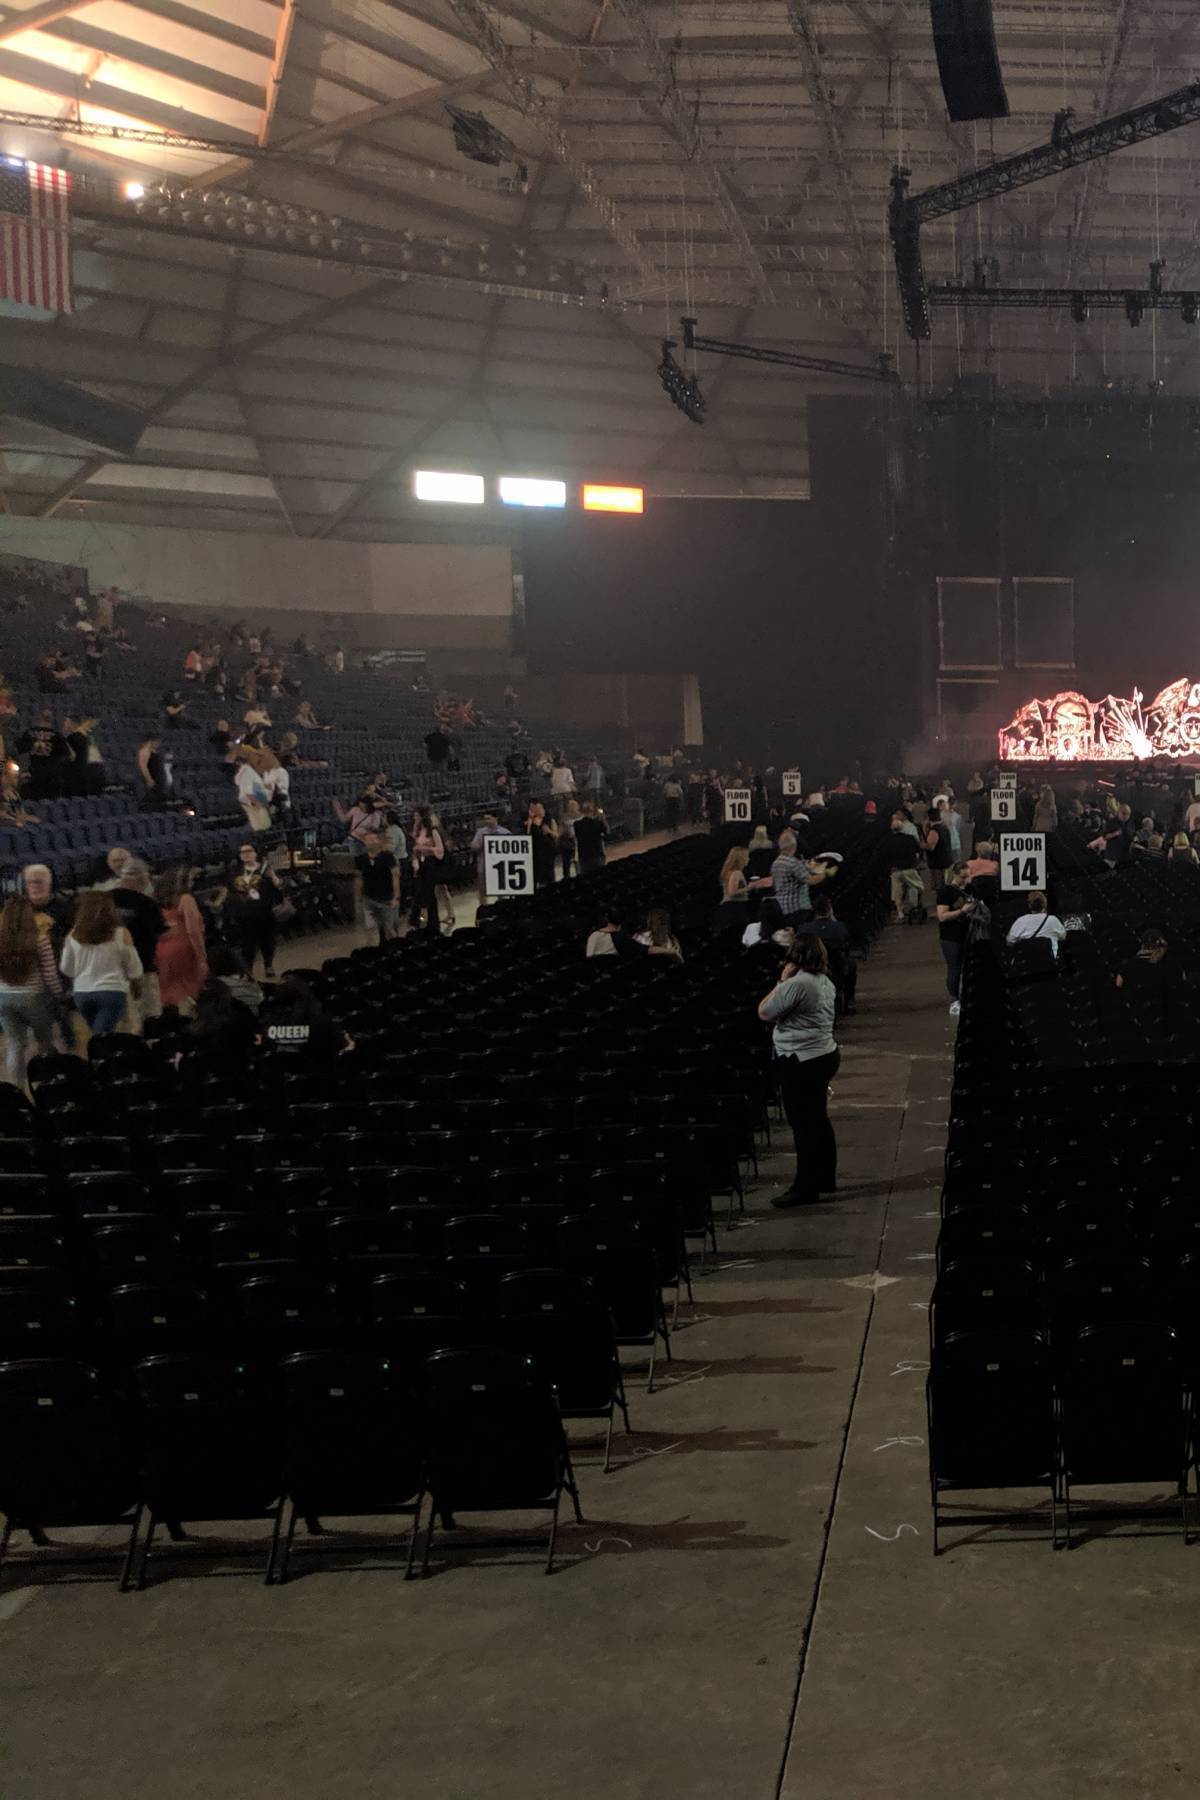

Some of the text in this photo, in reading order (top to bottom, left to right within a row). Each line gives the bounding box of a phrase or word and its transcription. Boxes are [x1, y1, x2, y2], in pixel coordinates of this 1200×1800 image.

[788, 782, 796, 793] 5
[727, 792, 749, 800] FLOOR
[992, 791, 1014, 799] FLOOR
[729, 803, 748, 819] 10
[998, 802, 1008, 817] 9
[487, 840, 529, 854] FLOOR
[1003, 838, 1042, 852] FLOOR
[492, 860, 527, 890] 15
[1007, 857, 1039, 886] 14
[268, 1025, 310, 1040] QUEEN
